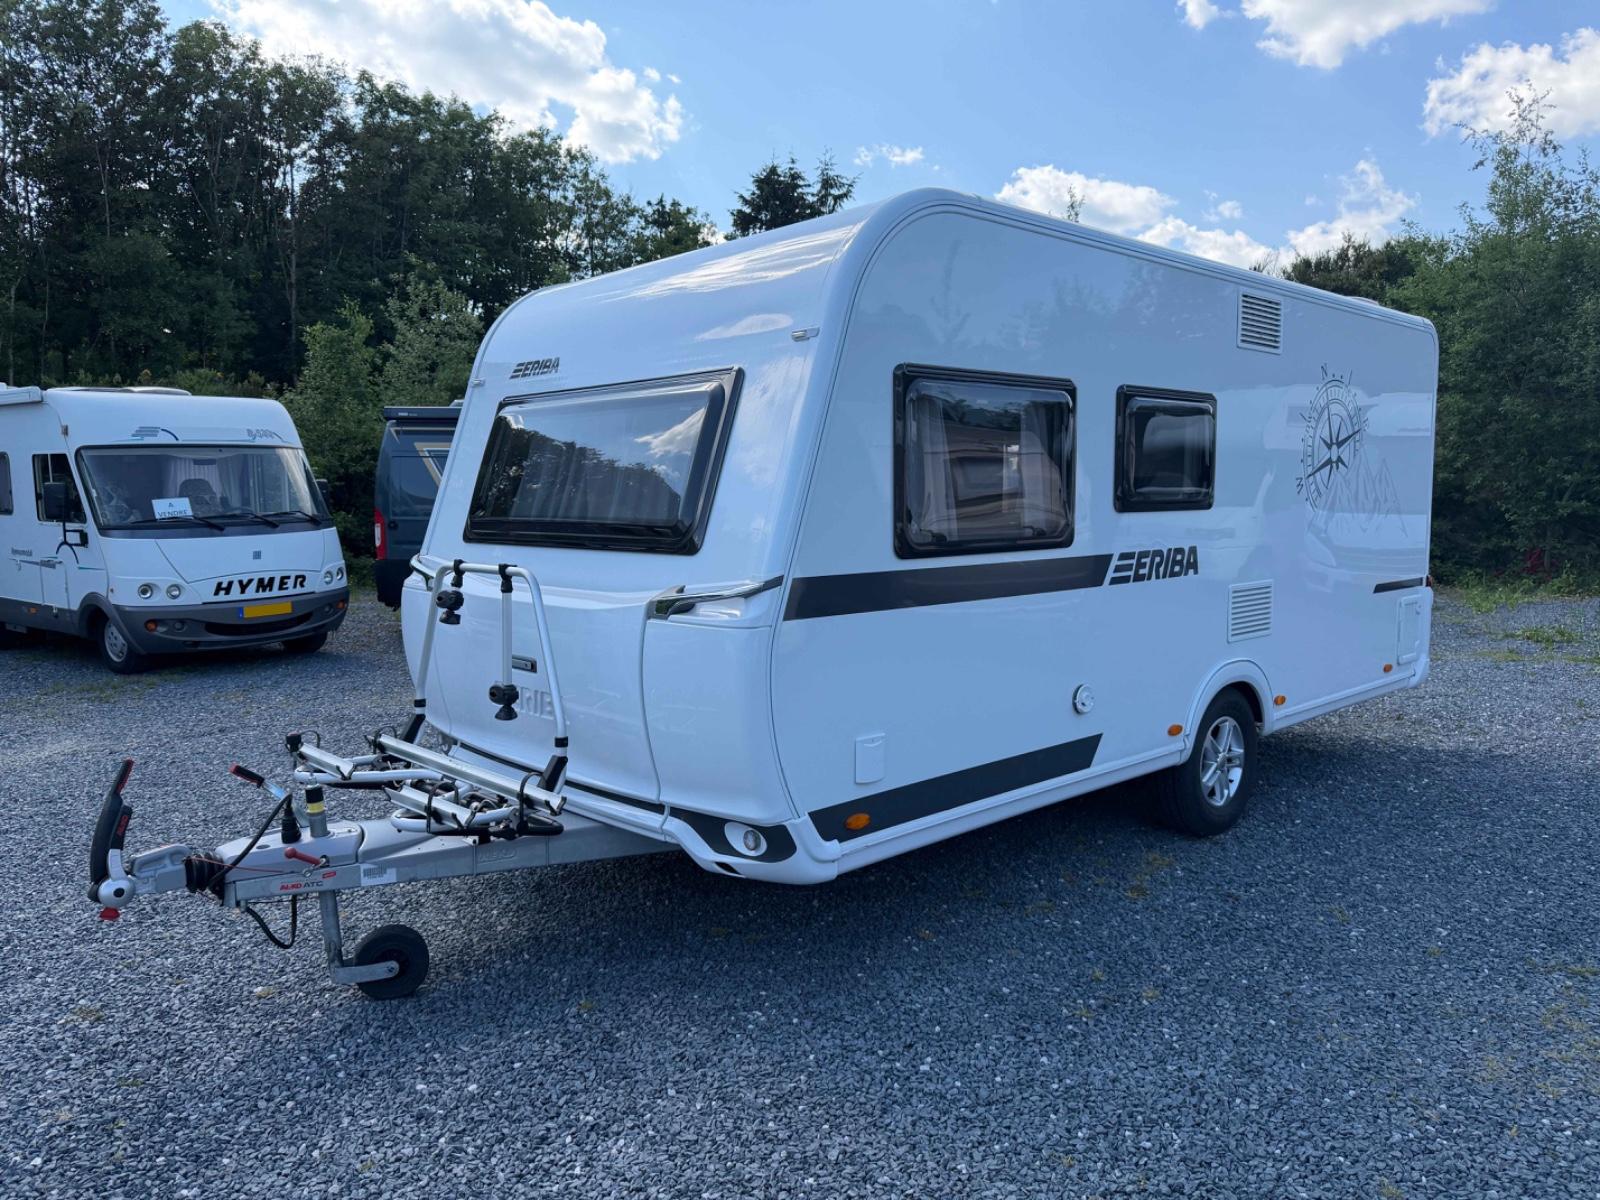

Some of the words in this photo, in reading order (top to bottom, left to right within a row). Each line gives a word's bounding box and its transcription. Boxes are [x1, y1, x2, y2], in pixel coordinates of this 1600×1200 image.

[509, 357, 560, 379] ERIBA
[1109, 545, 1199, 586] ERIBA
[213, 574, 307, 597] HYMER
[303, 881, 323, 889] ATC
